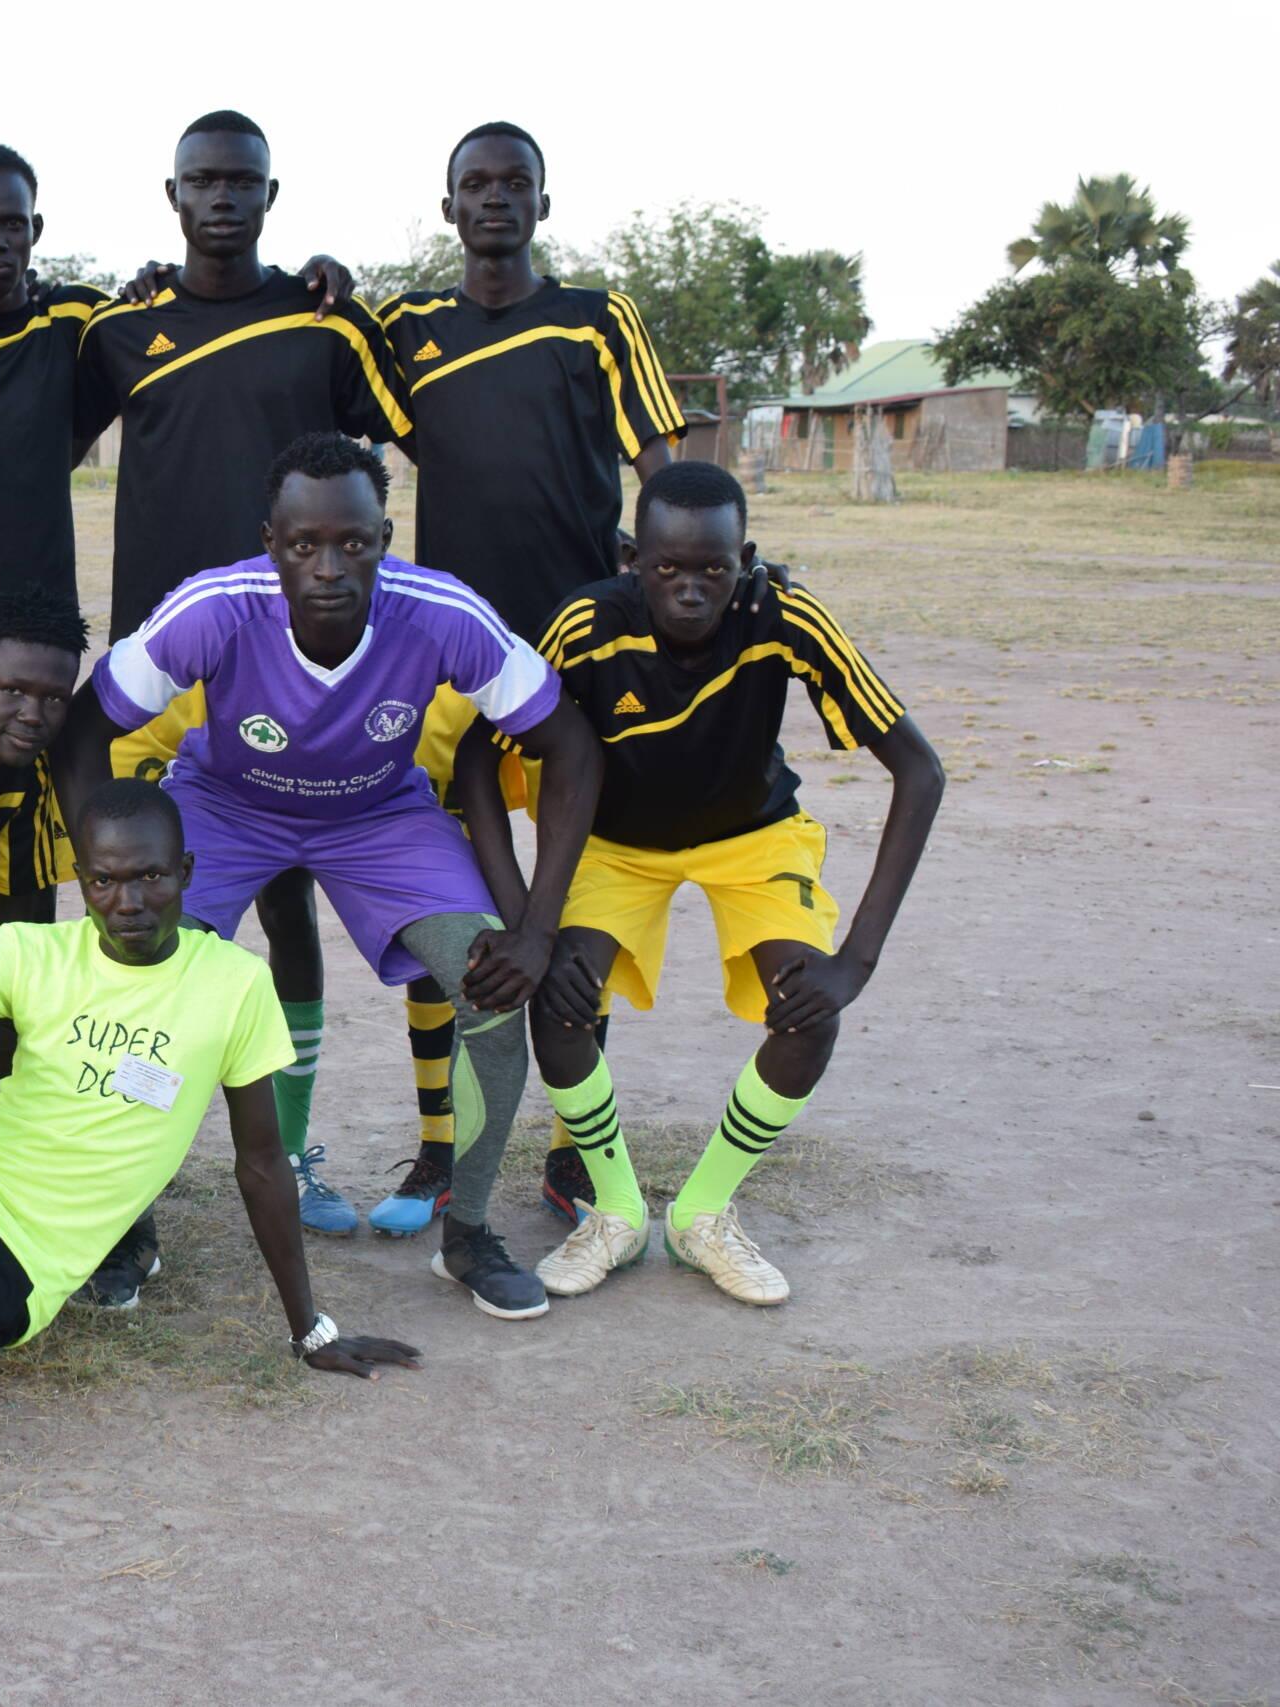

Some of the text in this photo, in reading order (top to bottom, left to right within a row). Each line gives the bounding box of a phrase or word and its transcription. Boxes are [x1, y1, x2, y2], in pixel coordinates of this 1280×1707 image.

[146, 342, 176, 356] adidas
[413, 349, 441, 361] adidas
[614, 704, 646, 715] adidas
[242, 773, 294, 792] through
[297, 787, 342, 797] Sports
[345, 785, 364, 794] for
[251, 768, 294, 786] Giving
[297, 778, 336, 787] Youth
[66, 1014, 170, 1066] SUPER
